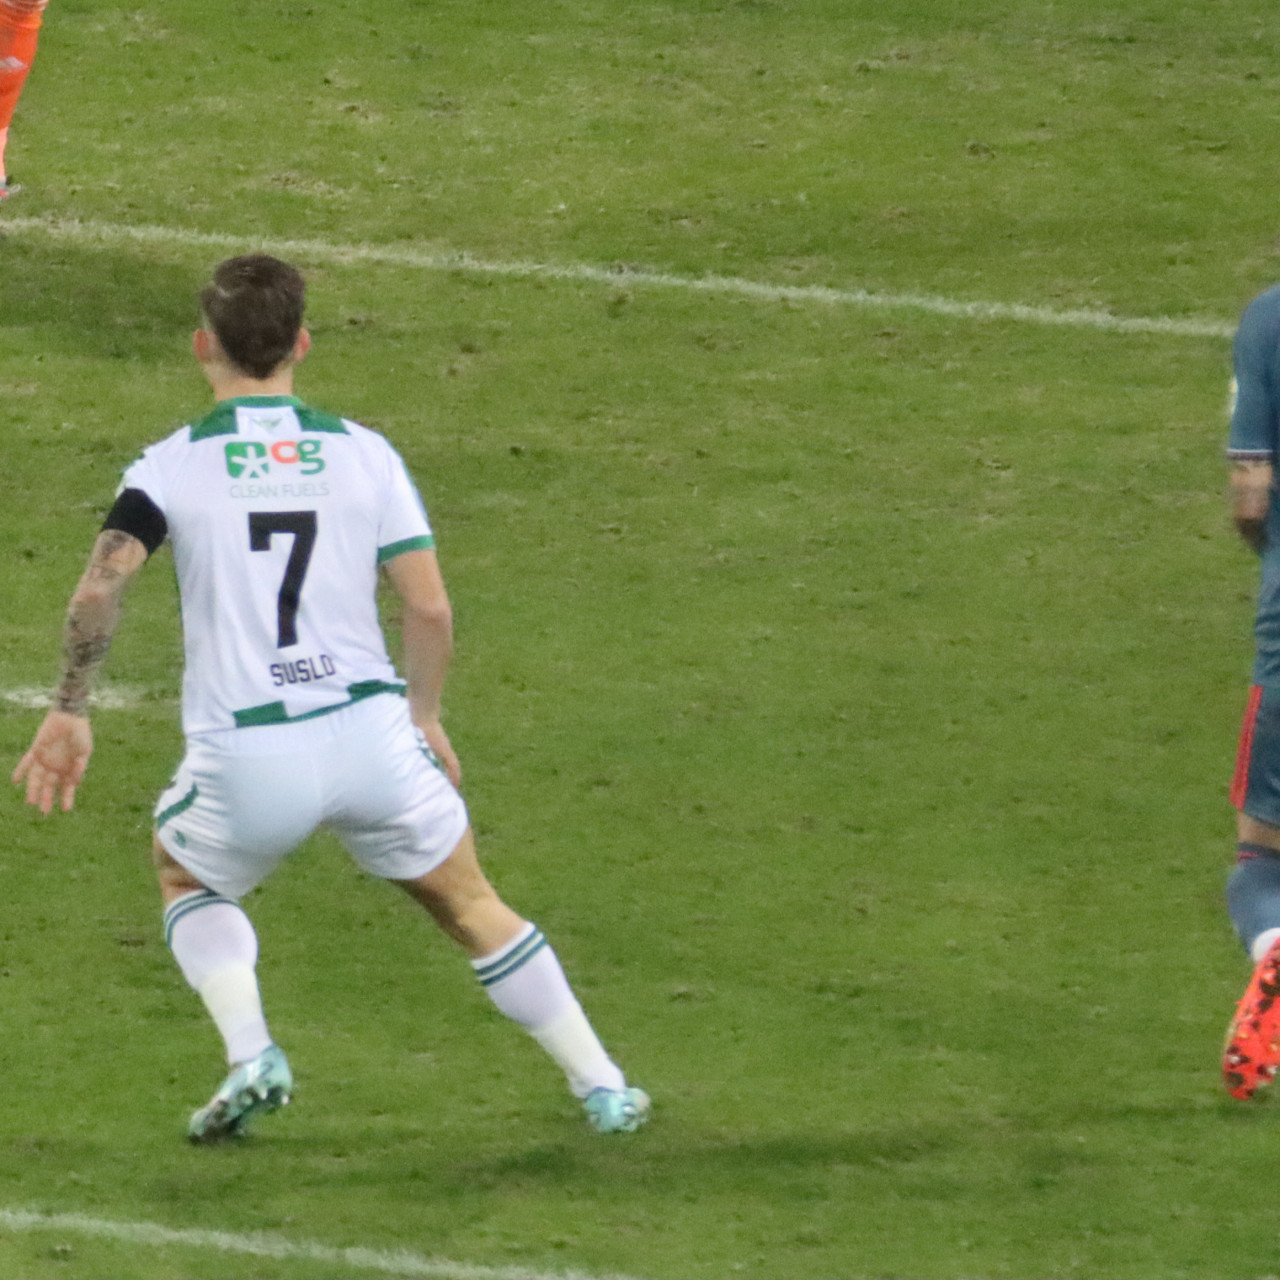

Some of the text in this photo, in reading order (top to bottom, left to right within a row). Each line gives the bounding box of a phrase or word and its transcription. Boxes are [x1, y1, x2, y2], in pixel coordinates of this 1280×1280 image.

[229, 481, 330, 499] CLEAN FUELS
[248, 510, 318, 649] 7
